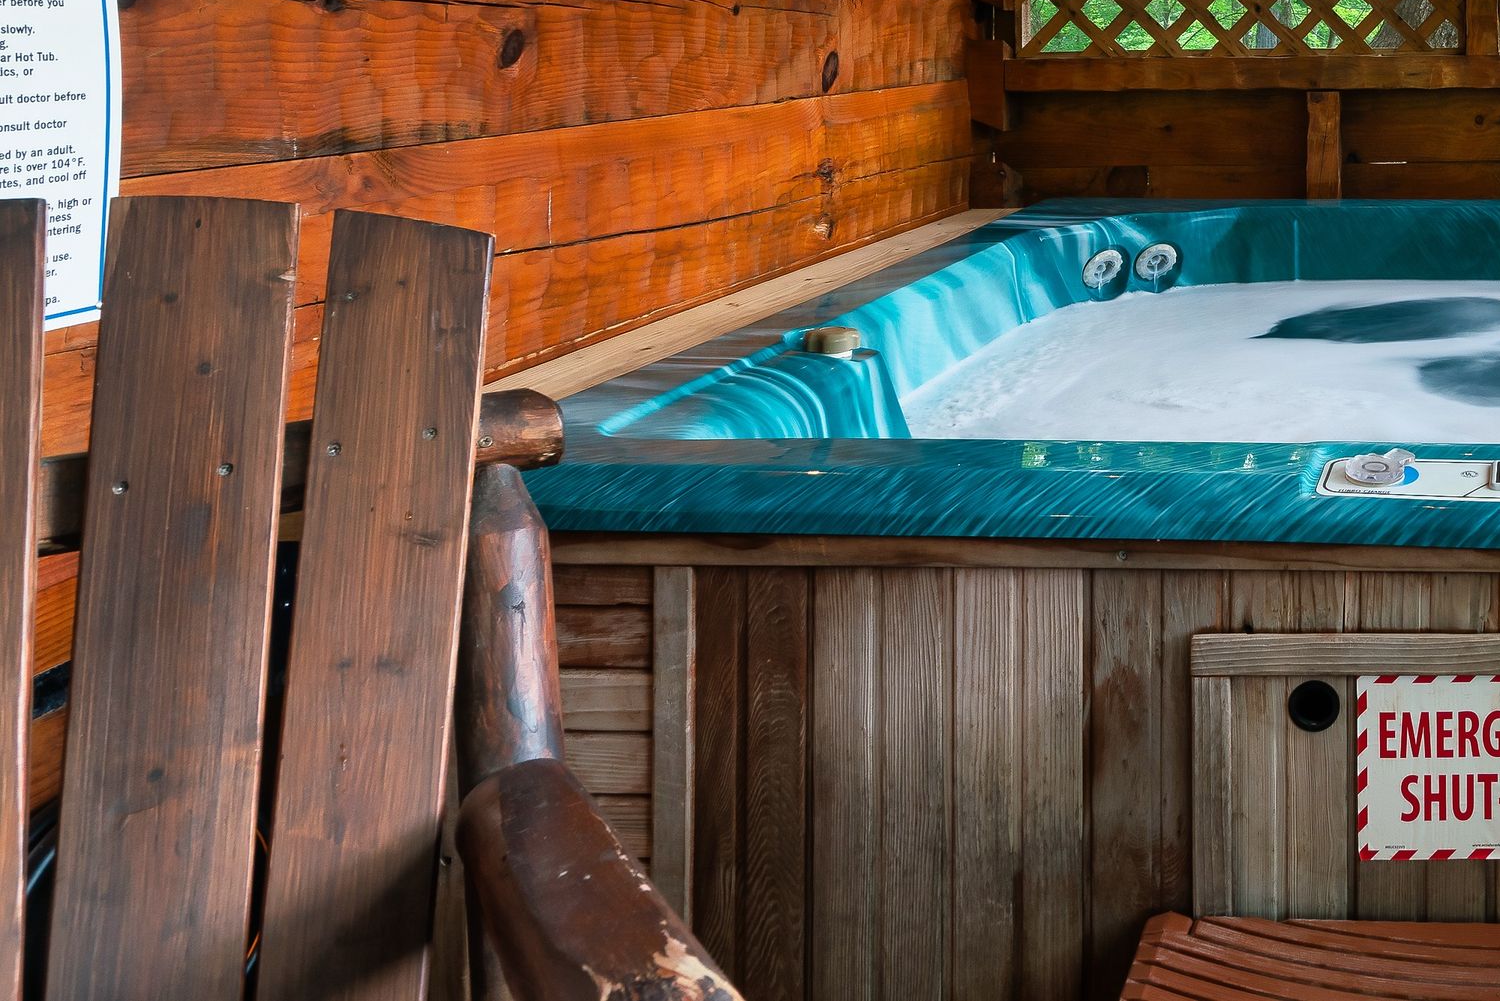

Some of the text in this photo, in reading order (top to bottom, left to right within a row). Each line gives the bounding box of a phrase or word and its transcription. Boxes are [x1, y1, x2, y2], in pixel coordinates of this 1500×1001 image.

[47, 0, 65, 9] you
[0, 24, 35, 36] slowly.
[15, 52, 34, 62] Hot
[37, 52, 59, 61] Tub.
[23, 68, 34, 76] or
[17, 93, 51, 104] doctor
[54, 91, 87, 102] before
[34, 119, 67, 130] doctor
[15, 149, 27, 160] by
[30, 149, 43, 157] an
[47, 145, 76, 156] adult.
[13, 164, 22, 173] is
[26, 162, 47, 172] over
[26, 175, 45, 186] and
[48, 172, 69, 183] cool
[73, 170, 87, 180] off
[57, 198, 79, 210] high
[82, 198, 92, 206] or
[52, 253, 72, 263] use.
